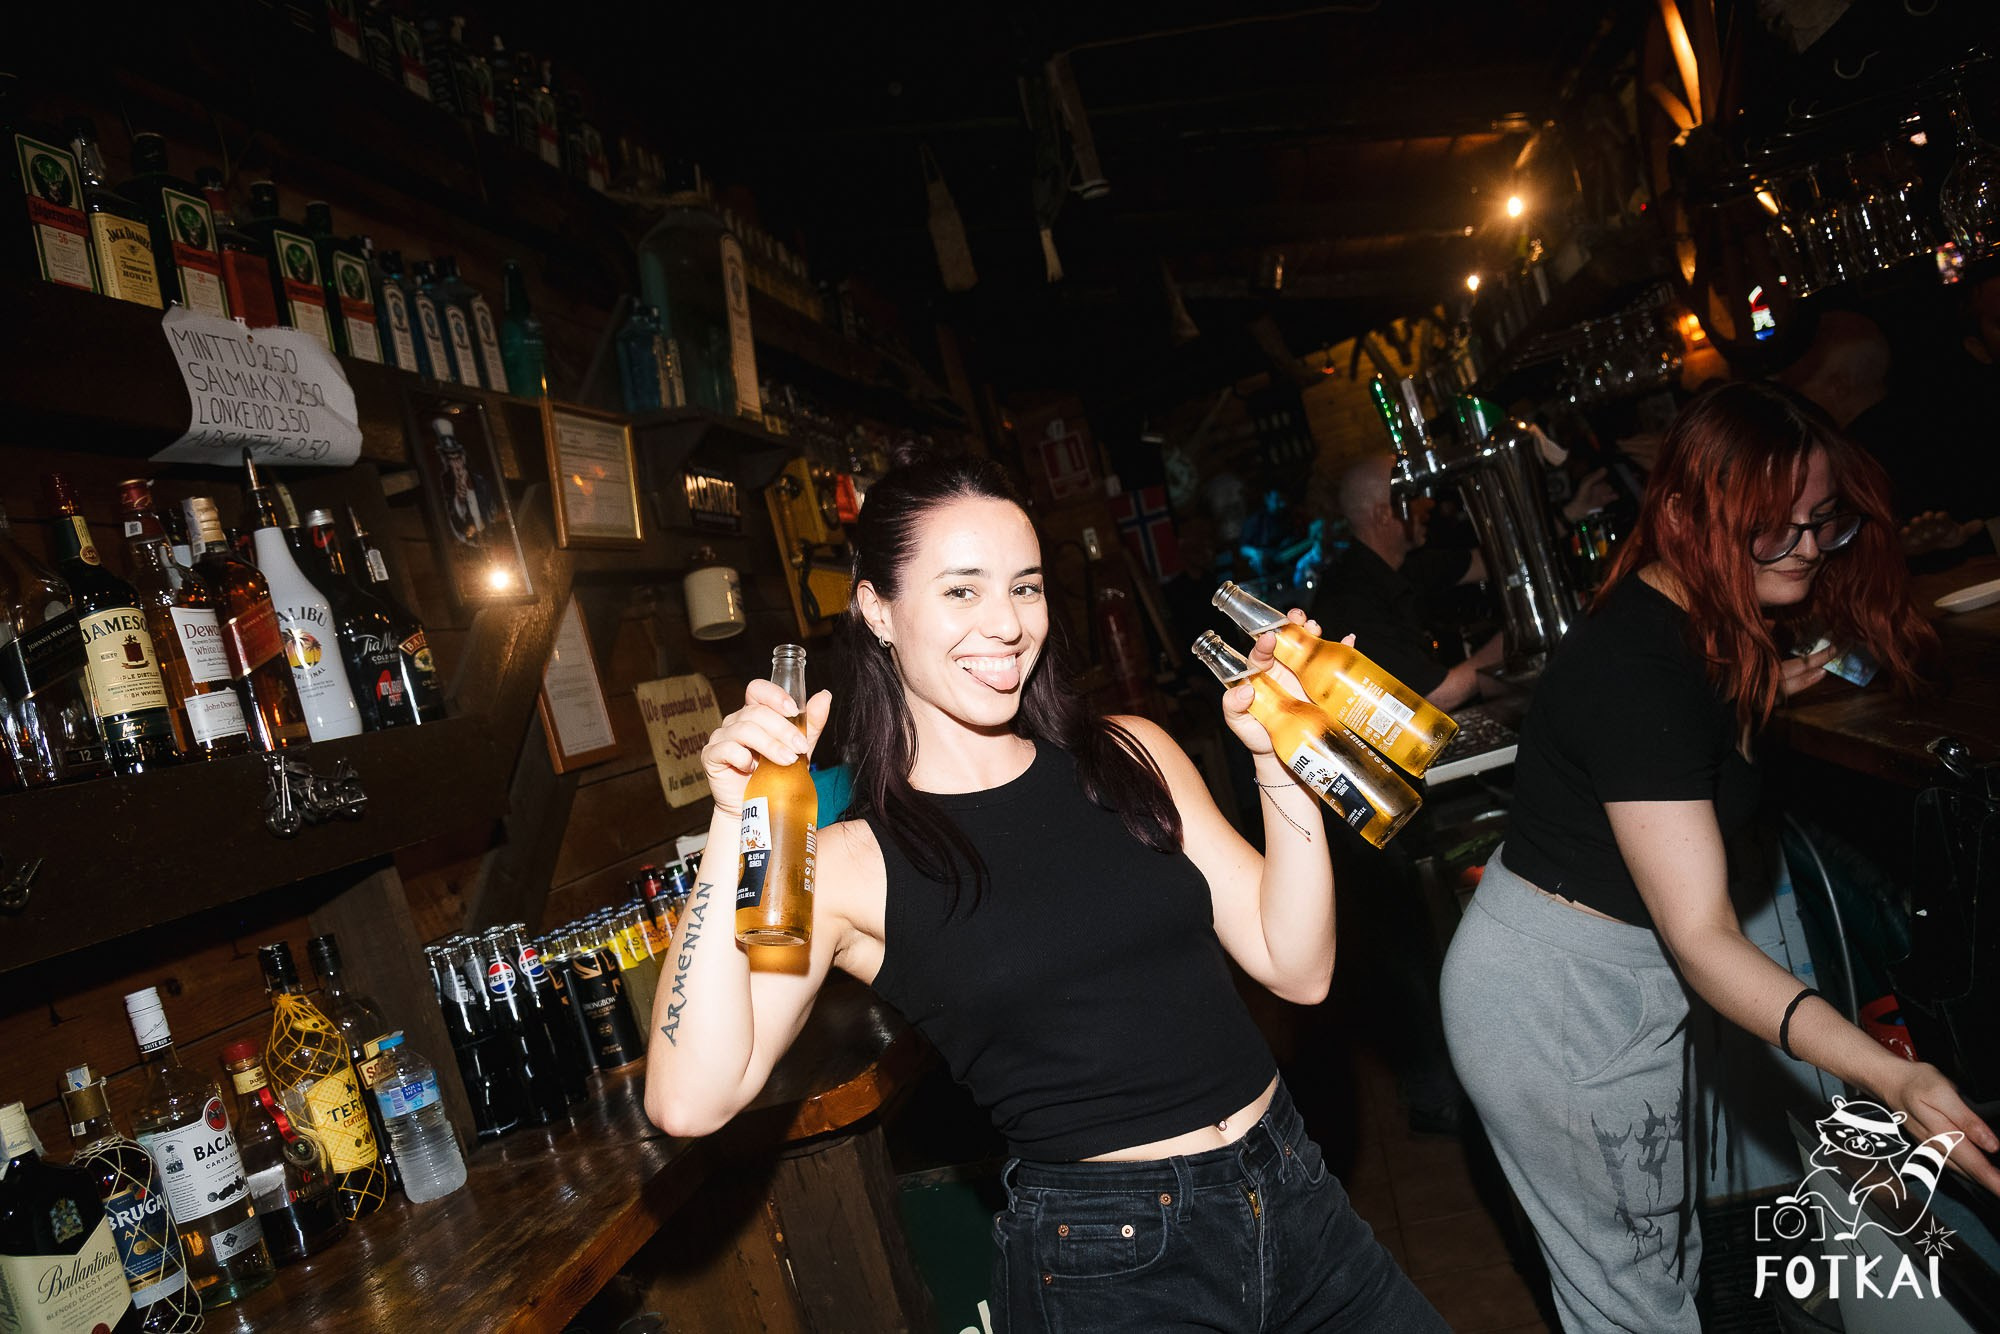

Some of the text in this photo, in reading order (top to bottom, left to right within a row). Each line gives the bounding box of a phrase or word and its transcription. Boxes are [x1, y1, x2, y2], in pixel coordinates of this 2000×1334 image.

[106, 228, 124, 243] JACK
[171, 327, 298, 375] MINTTU 2.50
[187, 362, 326, 407] SALMIAKKI 2.50
[197, 396, 311, 434] LONKERO 3.50
[27, 623, 75, 652] JOHNNIE WALKER
[79, 749, 92, 762] 12
[623, 936, 640, 954] KS
[661, 882, 713, 1047] ARMENIAN
[205, 1155, 229, 1169] CARTA
[69, 1275, 101, 1298] FINEST
[46, 1301, 78, 1320] BLENDED
[79, 1286, 102, 1303] SCOTCH
